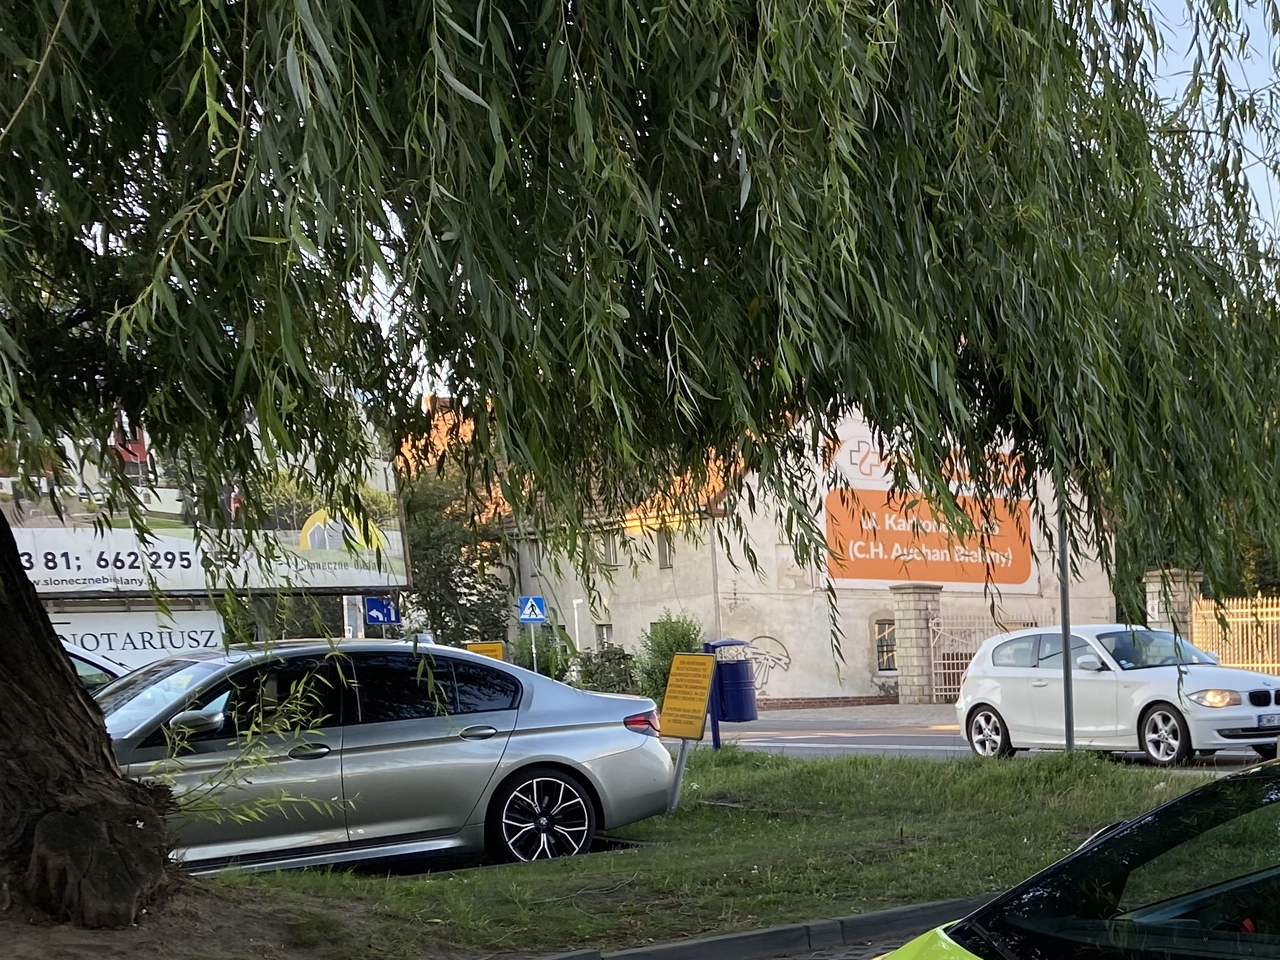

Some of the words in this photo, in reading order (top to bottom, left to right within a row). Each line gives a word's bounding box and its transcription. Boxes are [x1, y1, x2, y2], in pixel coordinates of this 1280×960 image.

[43, 551, 81, 572] 81;
[96, 550, 141, 570] 662
[150, 551, 192, 570] 295
[849, 540, 888, 562] (C.H.
[891, 543, 950, 563] Auchan
